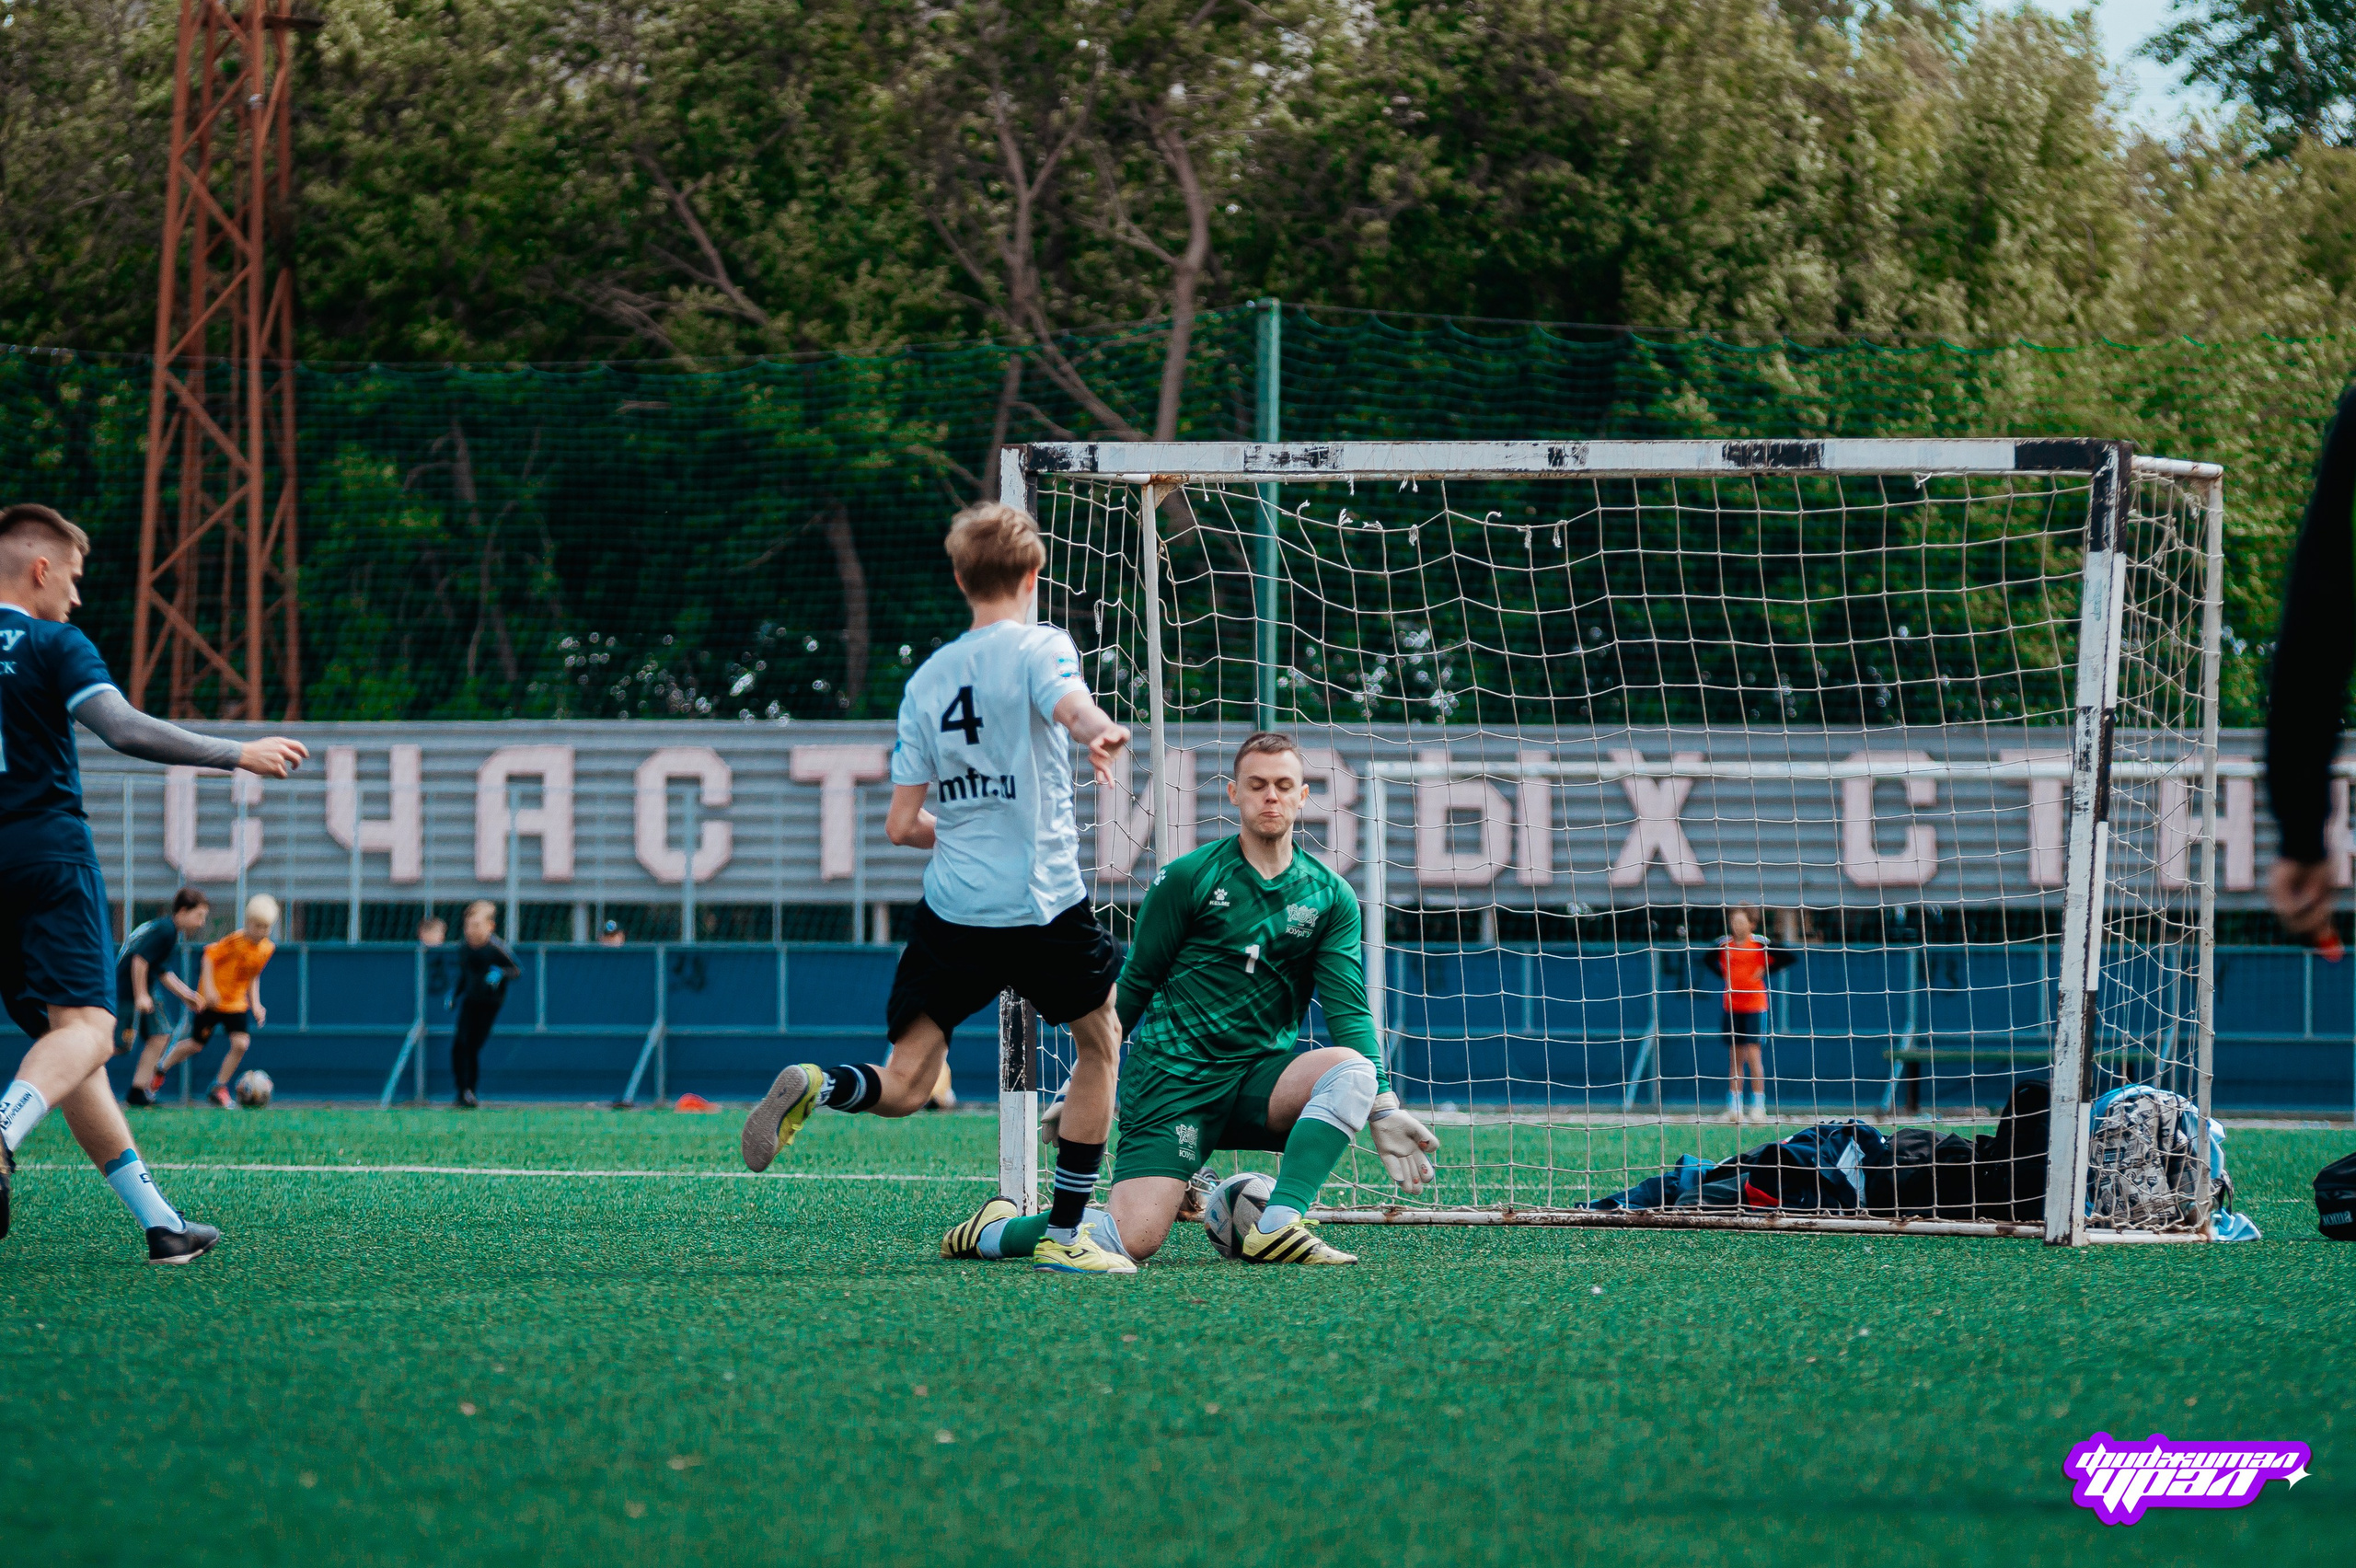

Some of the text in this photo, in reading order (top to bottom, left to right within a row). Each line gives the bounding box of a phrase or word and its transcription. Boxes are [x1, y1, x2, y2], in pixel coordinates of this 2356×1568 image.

[941, 685, 984, 745] 4
[164, 744, 1706, 886] СЧАСТИВЫХ
[1244, 944, 1260, 974] 1
